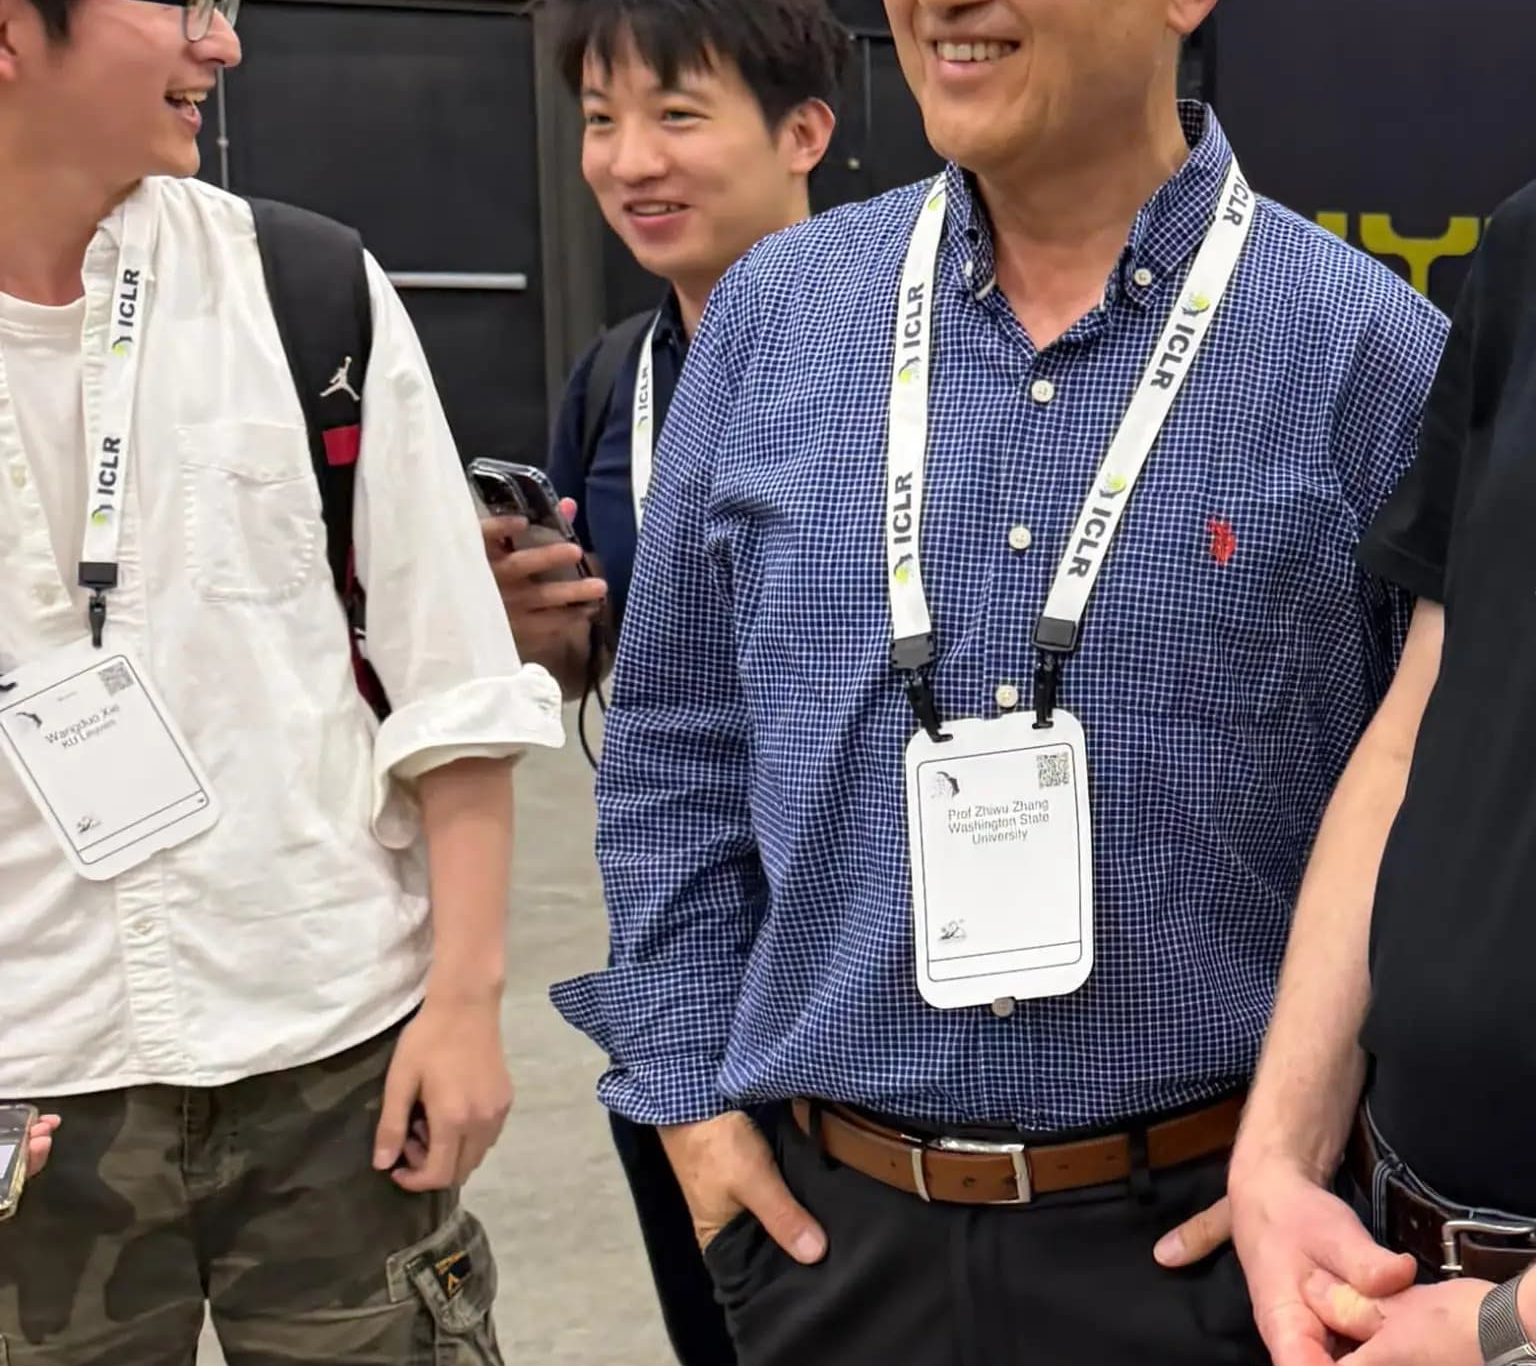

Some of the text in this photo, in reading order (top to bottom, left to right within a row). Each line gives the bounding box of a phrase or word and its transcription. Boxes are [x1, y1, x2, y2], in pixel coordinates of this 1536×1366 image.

[118, 268, 141, 329] ICLR
[903, 282, 925, 352] ICLR
[1150, 322, 1196, 391] ICLR
[97, 436, 121, 497] ICLR
[892, 471, 914, 547] ICLR
[1067, 508, 1112, 578] ICLR
[948, 817, 1016, 834] Washington
[972, 828, 1028, 845] University
